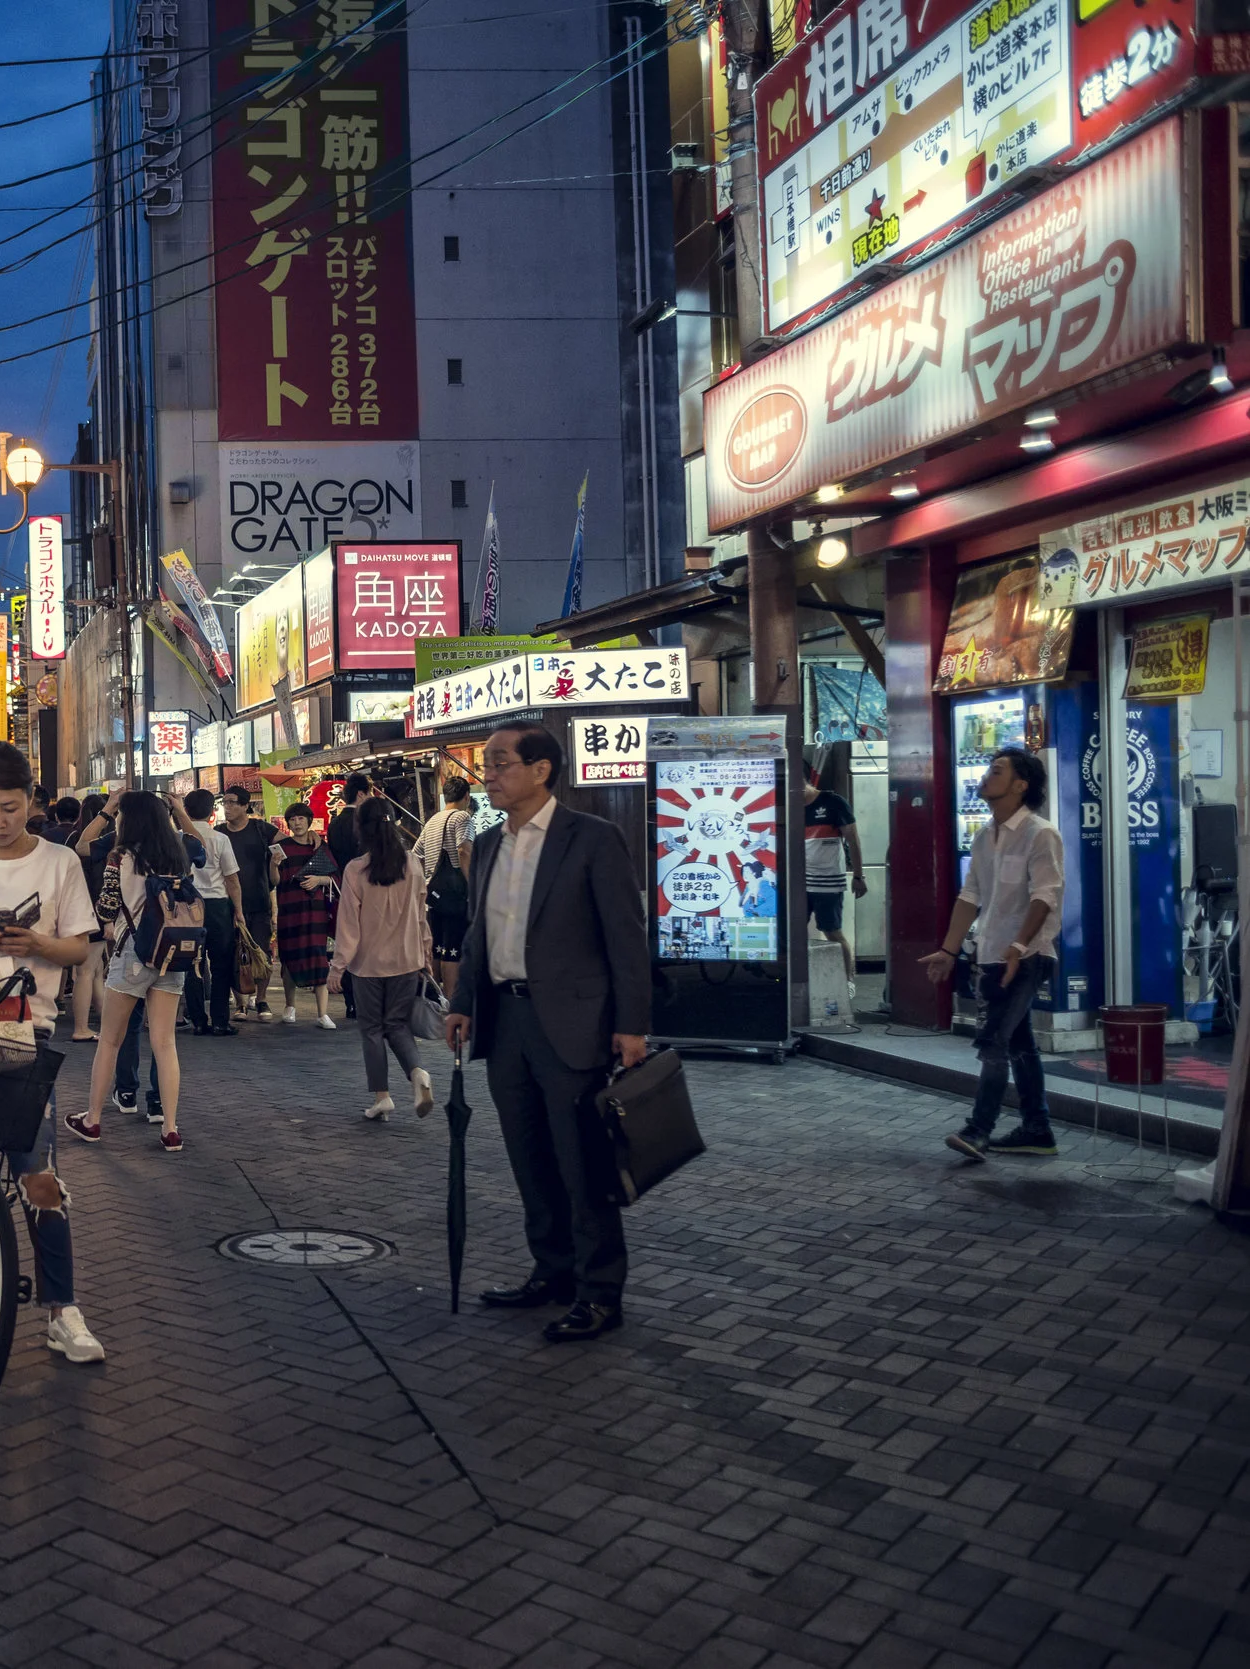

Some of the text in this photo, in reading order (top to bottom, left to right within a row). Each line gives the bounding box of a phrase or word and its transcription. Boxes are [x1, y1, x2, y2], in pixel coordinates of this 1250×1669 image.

[805, 0, 930, 129] 相席
[967, 3, 1057, 87] かに道楽本店
[1032, 40, 1052, 72] 7F
[895, 43, 951, 100] ビックカメラ
[853, 98, 882, 134] アムザ
[995, 120, 1038, 160] かに道楽
[820, 147, 872, 203] 千日前通り
[1006, 149, 1028, 173] 本店
[786, 184, 796, 248] 日本橋駅
[816, 207, 841, 232] WINS
[852, 213, 900, 267] 現在地
[982, 204, 1078, 273] Information
[984, 245, 1051, 296] Office in
[989, 252, 1081, 315] Restaurant
[326, 236, 353, 426] スロット 286台
[353, 235, 381, 426] パチンコ 372台
[829, 287, 943, 412] グルメ
[969, 256, 1127, 404] マップ
[733, 410, 793, 455] GOURMET
[750, 443, 777, 471] MAP
[229, 479, 414, 516] DRAGON
[1158, 505, 1191, 530] 飲食
[230, 517, 345, 553] GATE
[1121, 515, 1151, 540] 観光
[360, 554, 402, 562] DAIHATSU
[404, 553, 429, 562] MOVE
[352, 571, 448, 617] 角座
[355, 621, 448, 638] KADOZA
[494, 639, 528, 647] melonpan
[584, 661, 667, 692] 大たこ
[668, 653, 682, 695] 味の店
[156, 722, 188, 753] 薬
[1081, 801, 1159, 828] BSS
[672, 881, 713, 892] 徒歩2分
